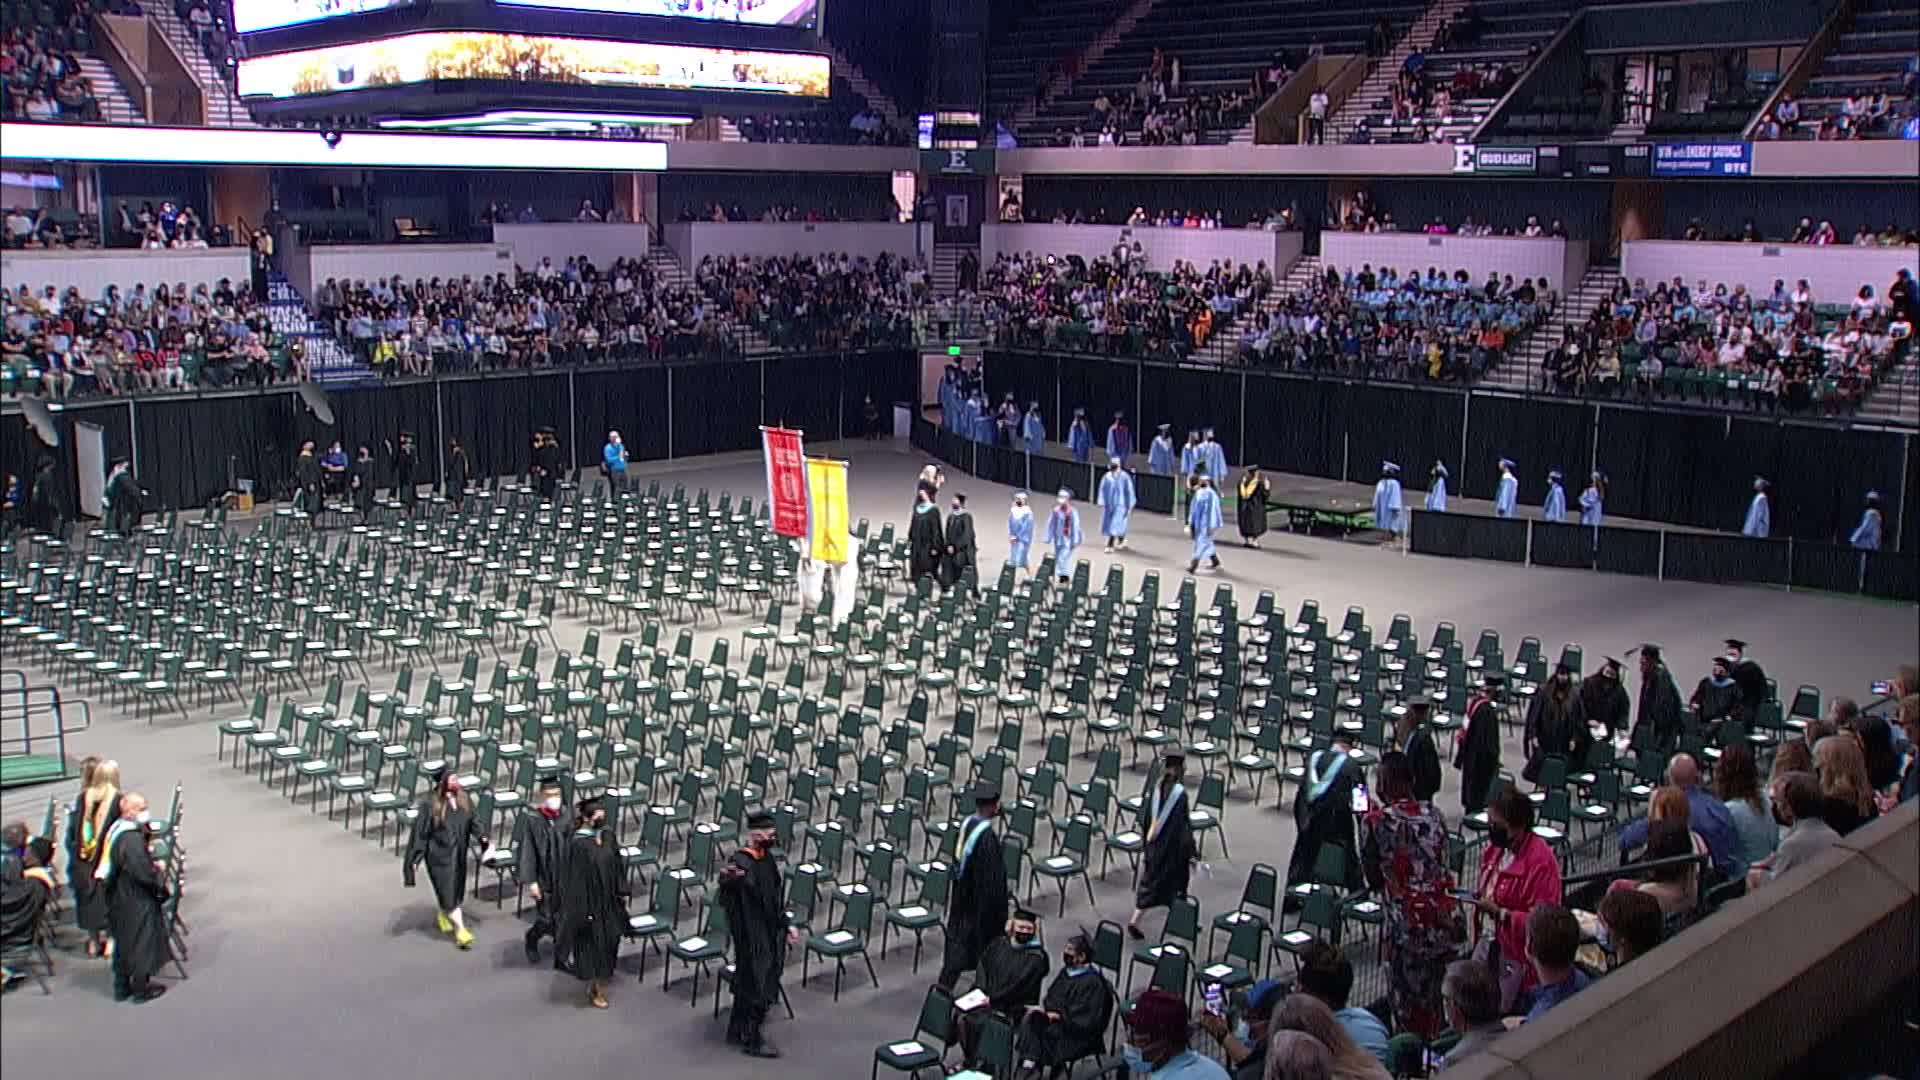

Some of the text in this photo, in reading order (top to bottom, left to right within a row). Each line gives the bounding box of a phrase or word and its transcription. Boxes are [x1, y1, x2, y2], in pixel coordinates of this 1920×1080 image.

[949, 151, 966, 167] E
[1454, 144, 1475, 173] E
[1481, 153, 1532, 165] BUD LIGHT
